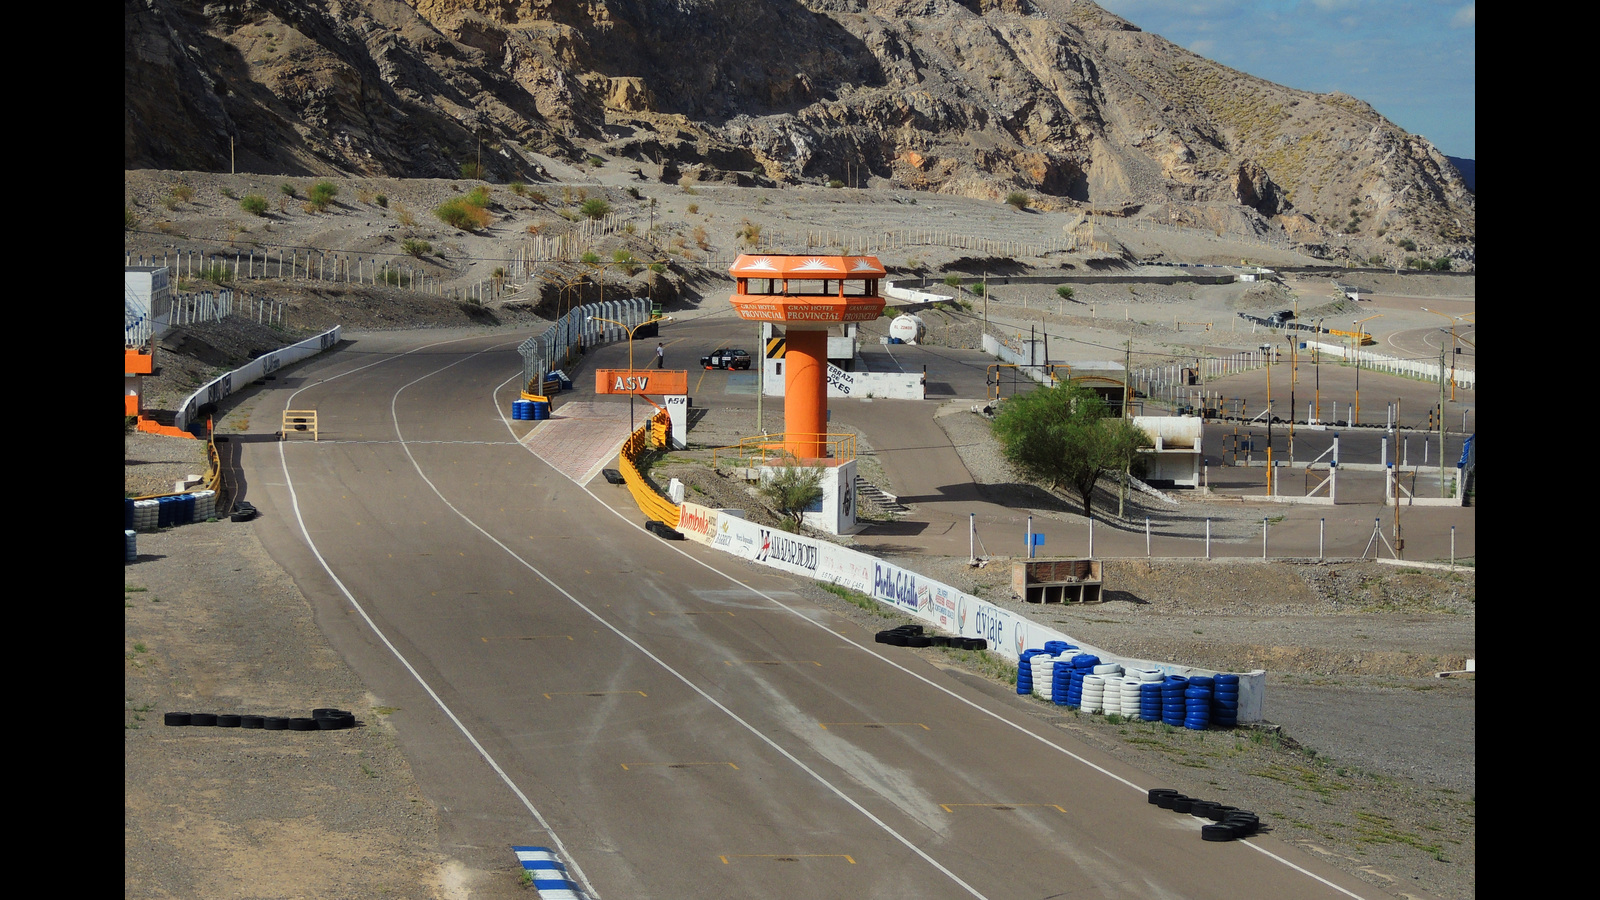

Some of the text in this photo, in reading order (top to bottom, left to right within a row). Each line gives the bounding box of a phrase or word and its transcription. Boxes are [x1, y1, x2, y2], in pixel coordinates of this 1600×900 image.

[740, 310, 783, 319] PROVINCIAL
[787, 311, 839, 320] PROVINCIAL
[844, 312, 877, 320] PROVINCIAL
[831, 373, 840, 381] DE
[614, 376, 649, 391] ASV
[667, 397, 685, 405] ASV
[679, 504, 708, 535] Rombola
[770, 535, 796, 564] ALKAZAR
[795, 542, 817, 571] HOTEL
